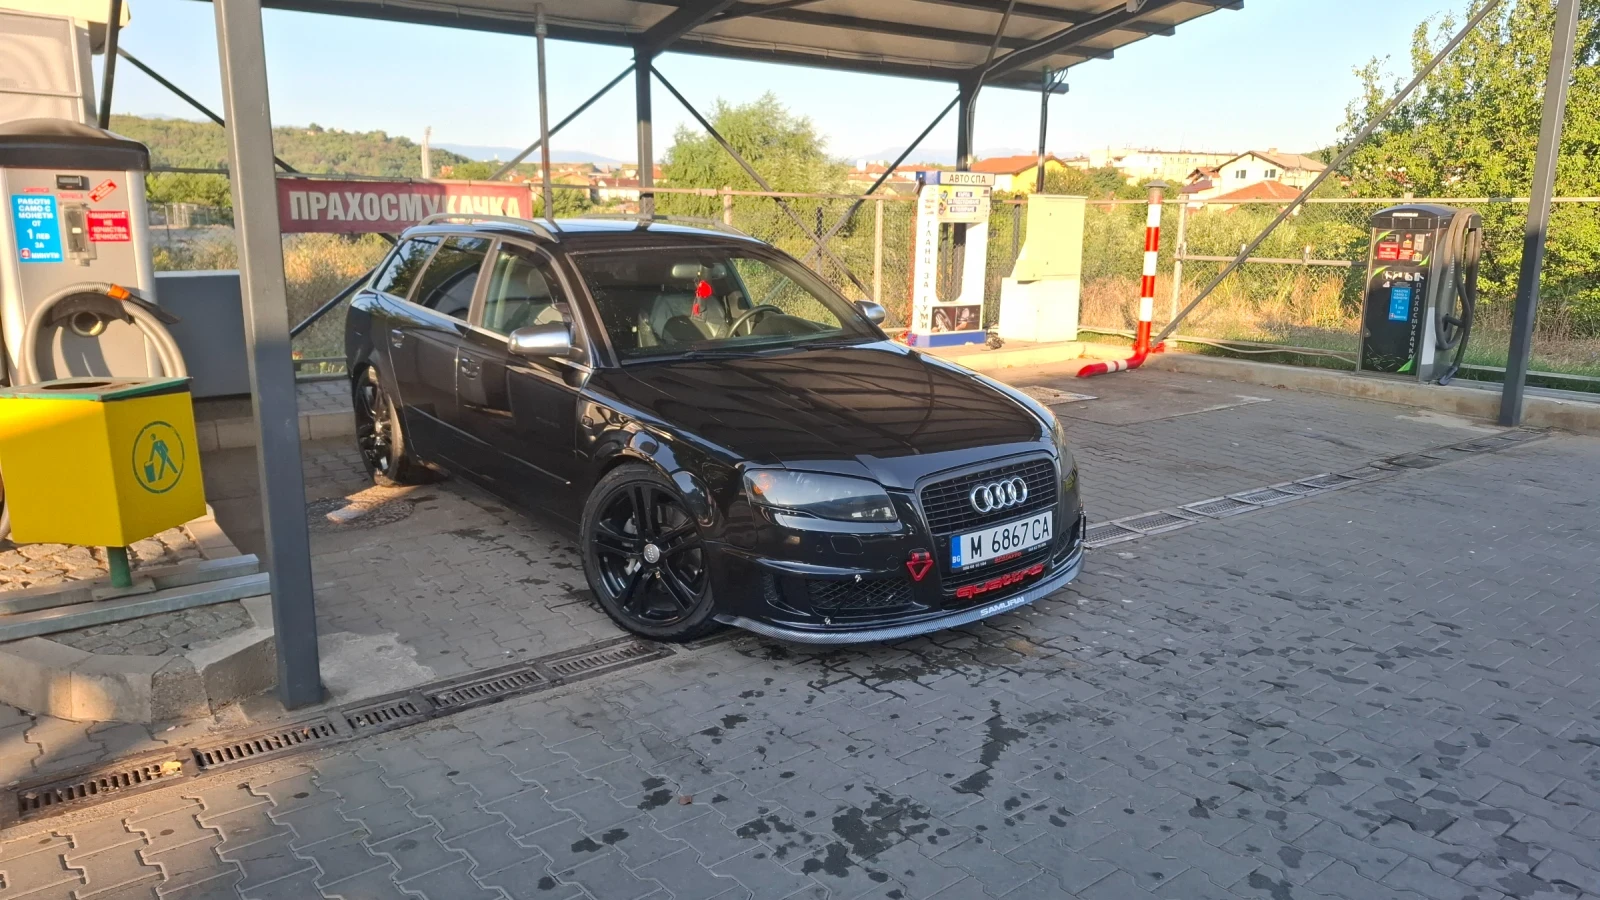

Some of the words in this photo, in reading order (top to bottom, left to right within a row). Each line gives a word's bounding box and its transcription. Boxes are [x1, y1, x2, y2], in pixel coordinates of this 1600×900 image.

[949, 174, 969, 183] АВТО
[971, 175, 986, 183] СПА
[289, 191, 521, 222] ПРАХОСМУКАЧКА
[26, 228, 33, 240] 1
[34, 241, 45, 249] ЗА
[924, 273, 929, 288] ЗА
[920, 295, 929, 329] ГУМИ
[1408, 282, 1422, 360] ПРАХОСМУКАЧКА
[970, 535, 982, 559] M
[992, 522, 1029, 553] 6867
[1032, 516, 1050, 541] CA
[952, 555, 961, 563] BG
[956, 563, 1044, 598] quattro
[980, 597, 1024, 616] SAMURAI
